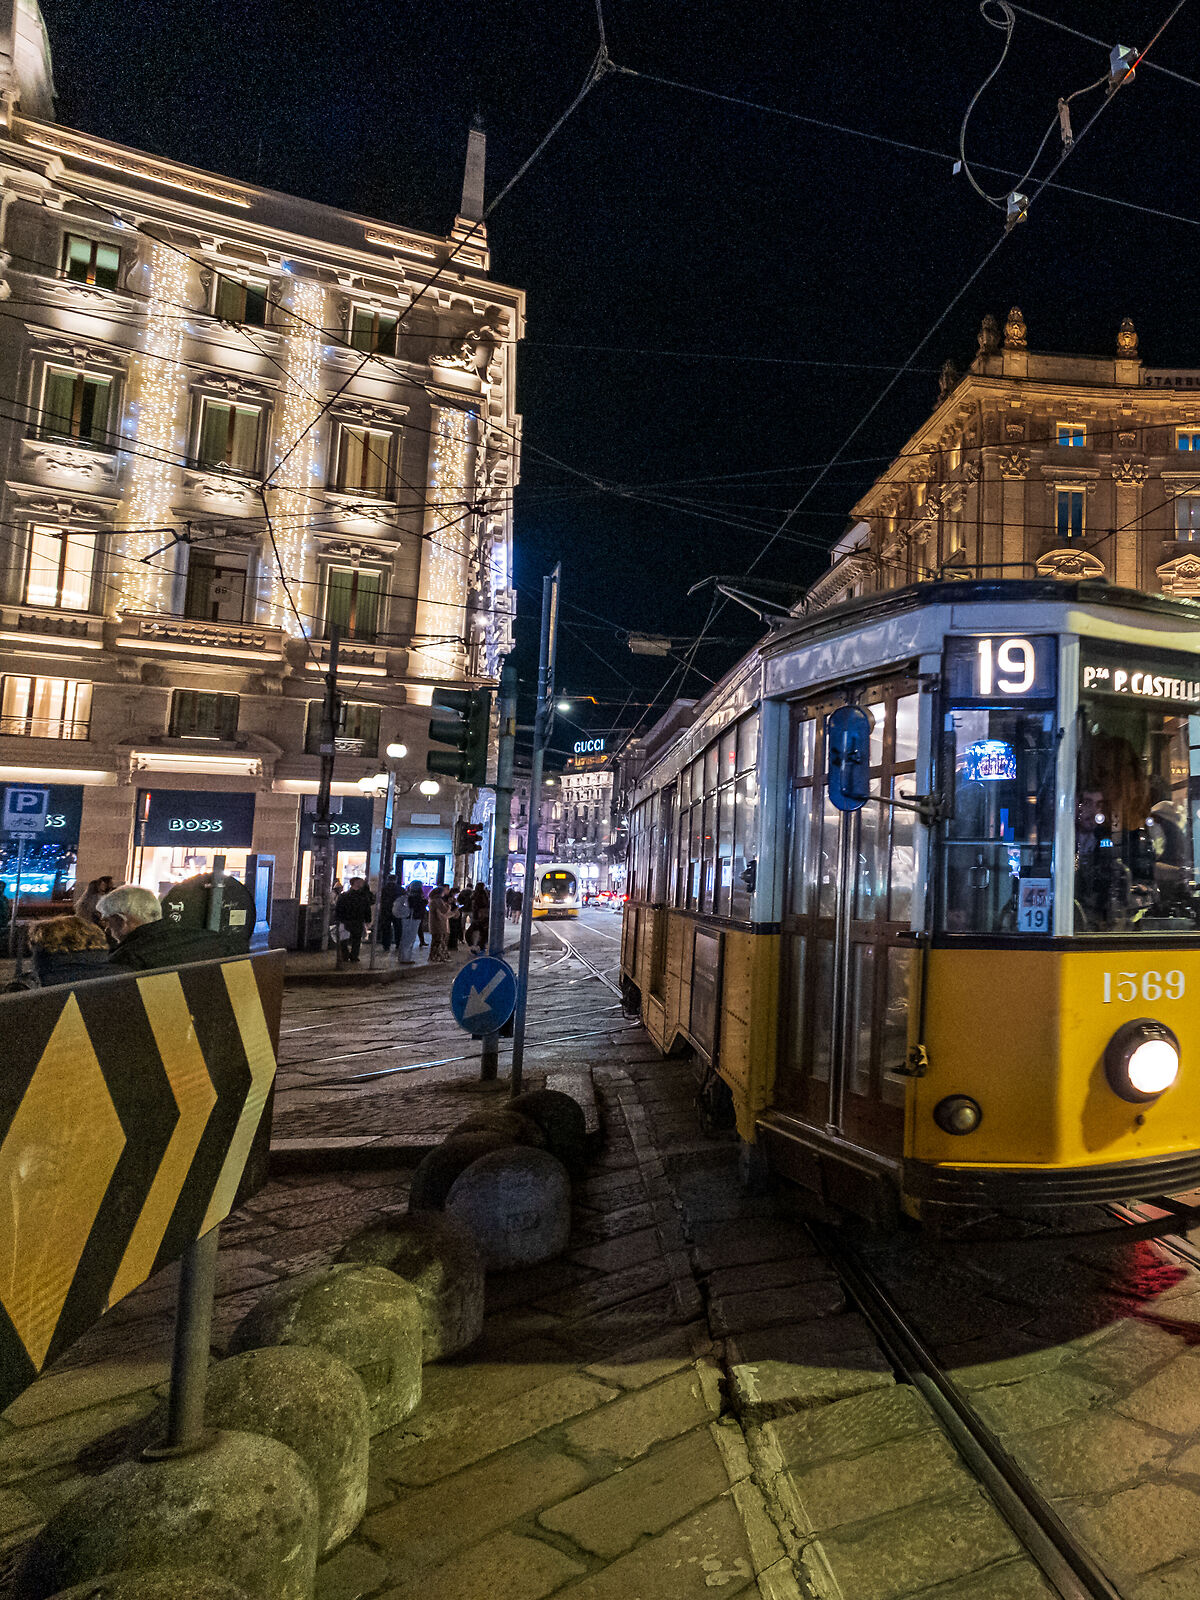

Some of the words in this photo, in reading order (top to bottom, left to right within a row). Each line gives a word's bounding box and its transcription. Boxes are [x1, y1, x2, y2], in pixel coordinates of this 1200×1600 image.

[978, 638, 1036, 695] 19
[574, 738, 605, 753] GUCCI
[16, 793, 38, 811] P
[169, 818, 223, 832] BOSS
[312, 822, 361, 836] OSS
[1025, 910, 1044, 928] 19
[1103, 970, 1186, 1004] 1569
